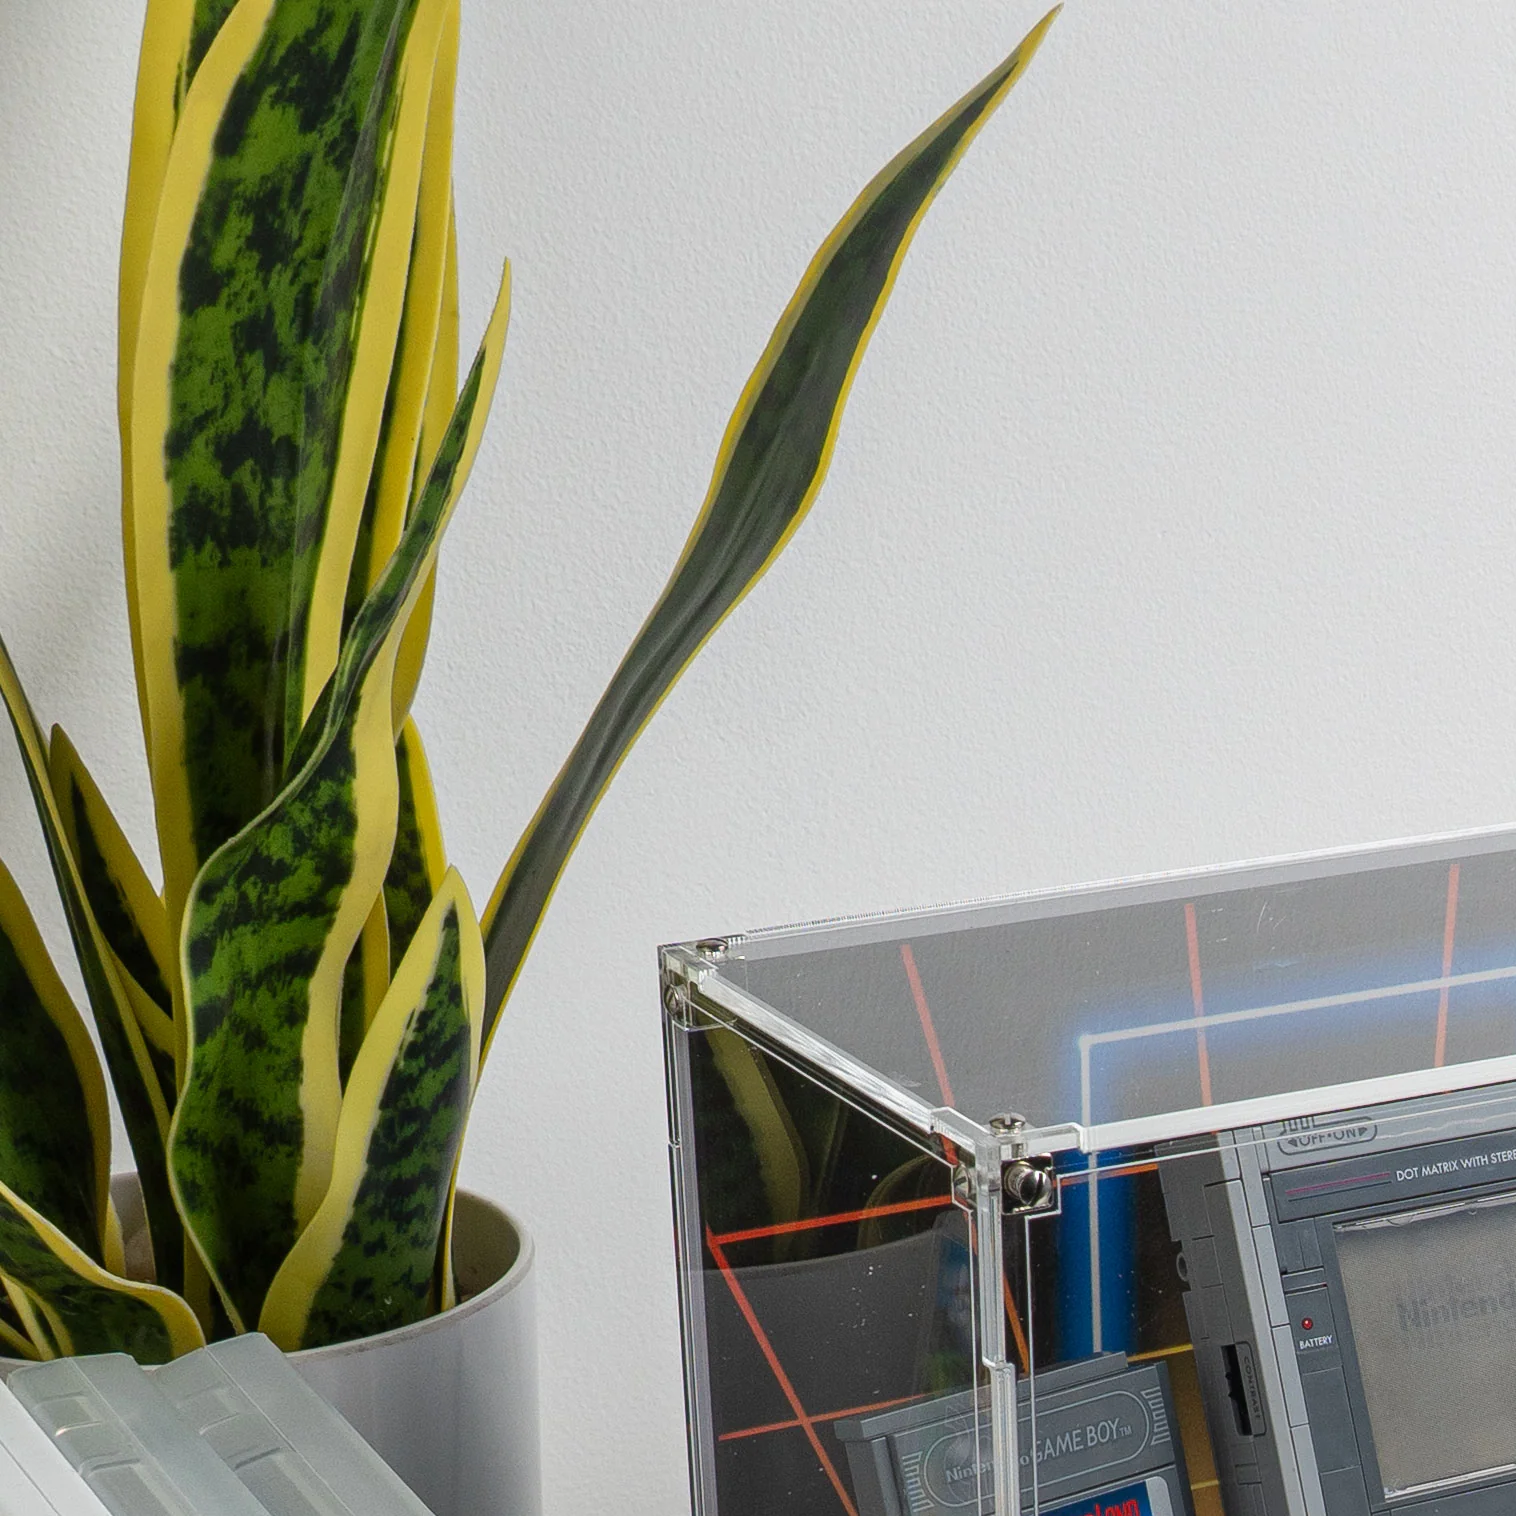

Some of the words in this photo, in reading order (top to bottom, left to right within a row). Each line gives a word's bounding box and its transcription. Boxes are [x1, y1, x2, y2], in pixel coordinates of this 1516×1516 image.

[1396, 1167, 1420, 1183] DOT
[1421, 1161, 1460, 1178] MATRIX
[1460, 1154, 1490, 1170] WITH
[1299, 1335, 1333, 1350] BATTERY
[945, 1453, 1030, 1483] Ninteno
